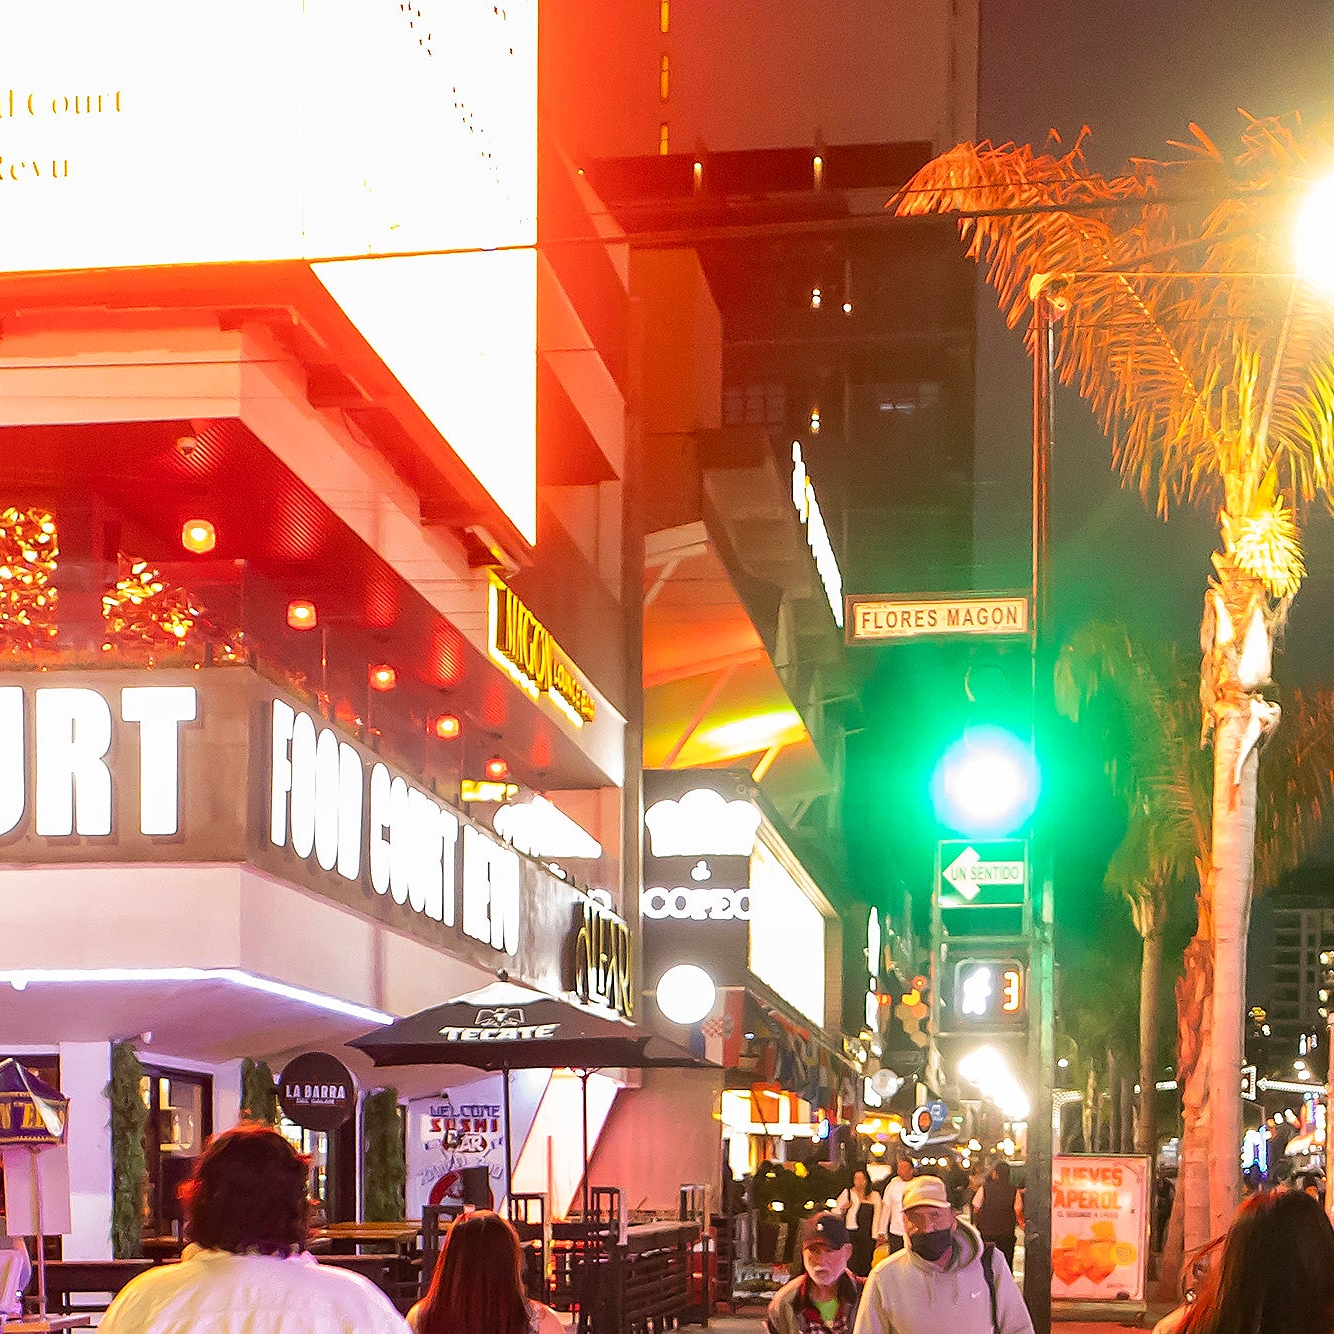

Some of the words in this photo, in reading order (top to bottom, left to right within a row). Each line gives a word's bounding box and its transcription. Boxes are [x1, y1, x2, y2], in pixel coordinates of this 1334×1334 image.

[861, 609, 938, 629] FLORES
[946, 606, 1018, 627] MAGON
[950, 866, 967, 881] UN
[970, 865, 1020, 881] SENTIDO
[438, 1022, 561, 1041] TECATE
[285, 1084, 301, 1098] LA
[304, 1084, 347, 1099] BARRA
[429, 1104, 501, 1118] WELCOME
[429, 1117, 499, 1133] SUSHI
